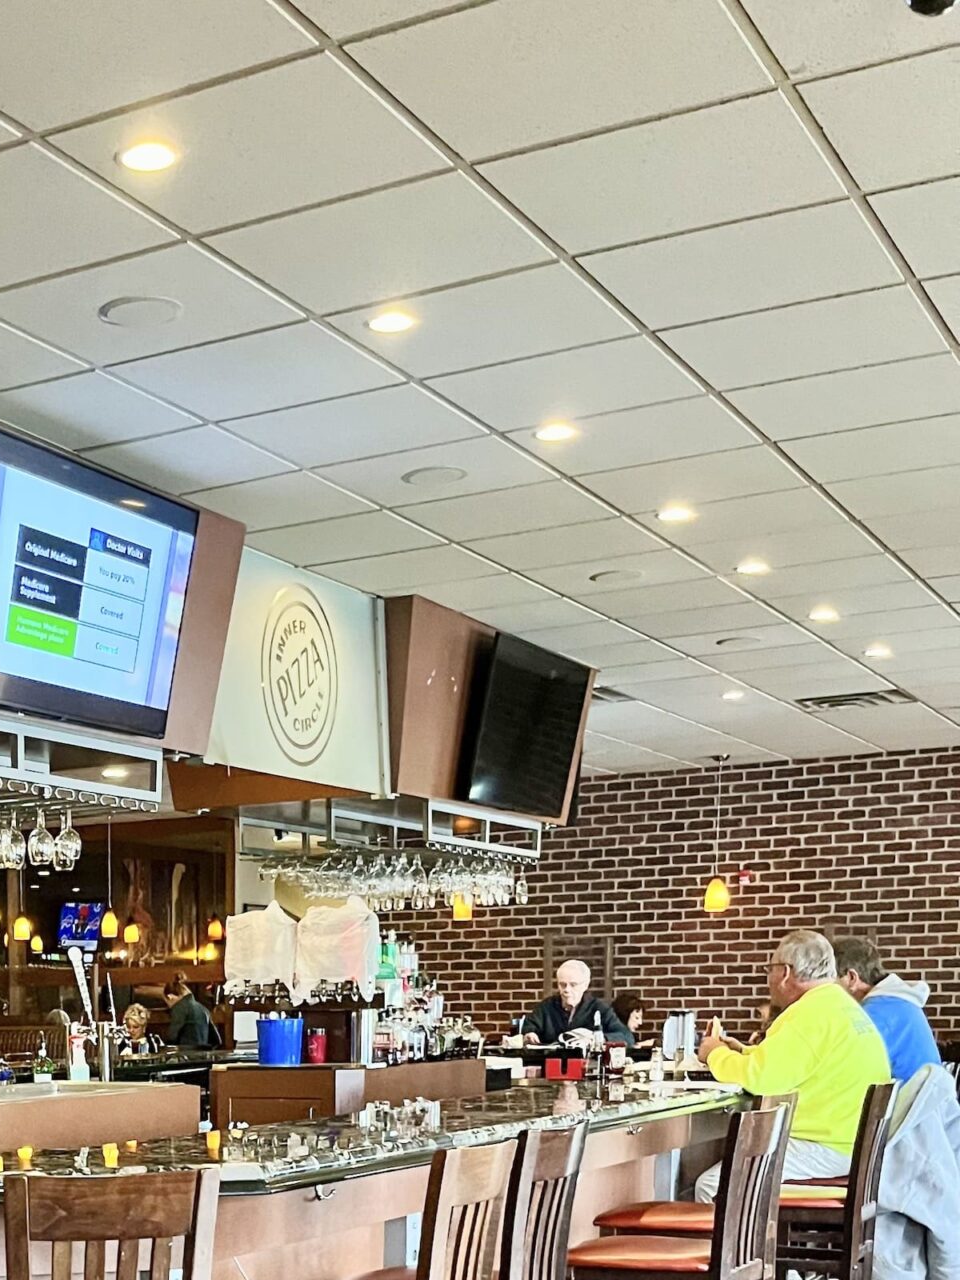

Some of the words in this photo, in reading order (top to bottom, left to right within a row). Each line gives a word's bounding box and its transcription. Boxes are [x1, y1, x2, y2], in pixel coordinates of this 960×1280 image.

[25, 541, 50, 557] Original
[50, 549, 77, 567] Medicare
[106, 538, 127, 554] Doctor
[127, 545, 144, 560] Visits
[21, 576, 49, 593] Medicare
[99, 566, 110, 577] You
[110, 572, 121, 583] pay
[122, 574, 136, 585] 20%
[20, 585, 56, 605] Supplement
[100, 606, 124, 620] Covered
[96, 642, 119, 655] Covered
[276, 619, 307, 663] INNER
[276, 637, 325, 718] PIZZA
[293, 689, 324, 733] CIRCLE
